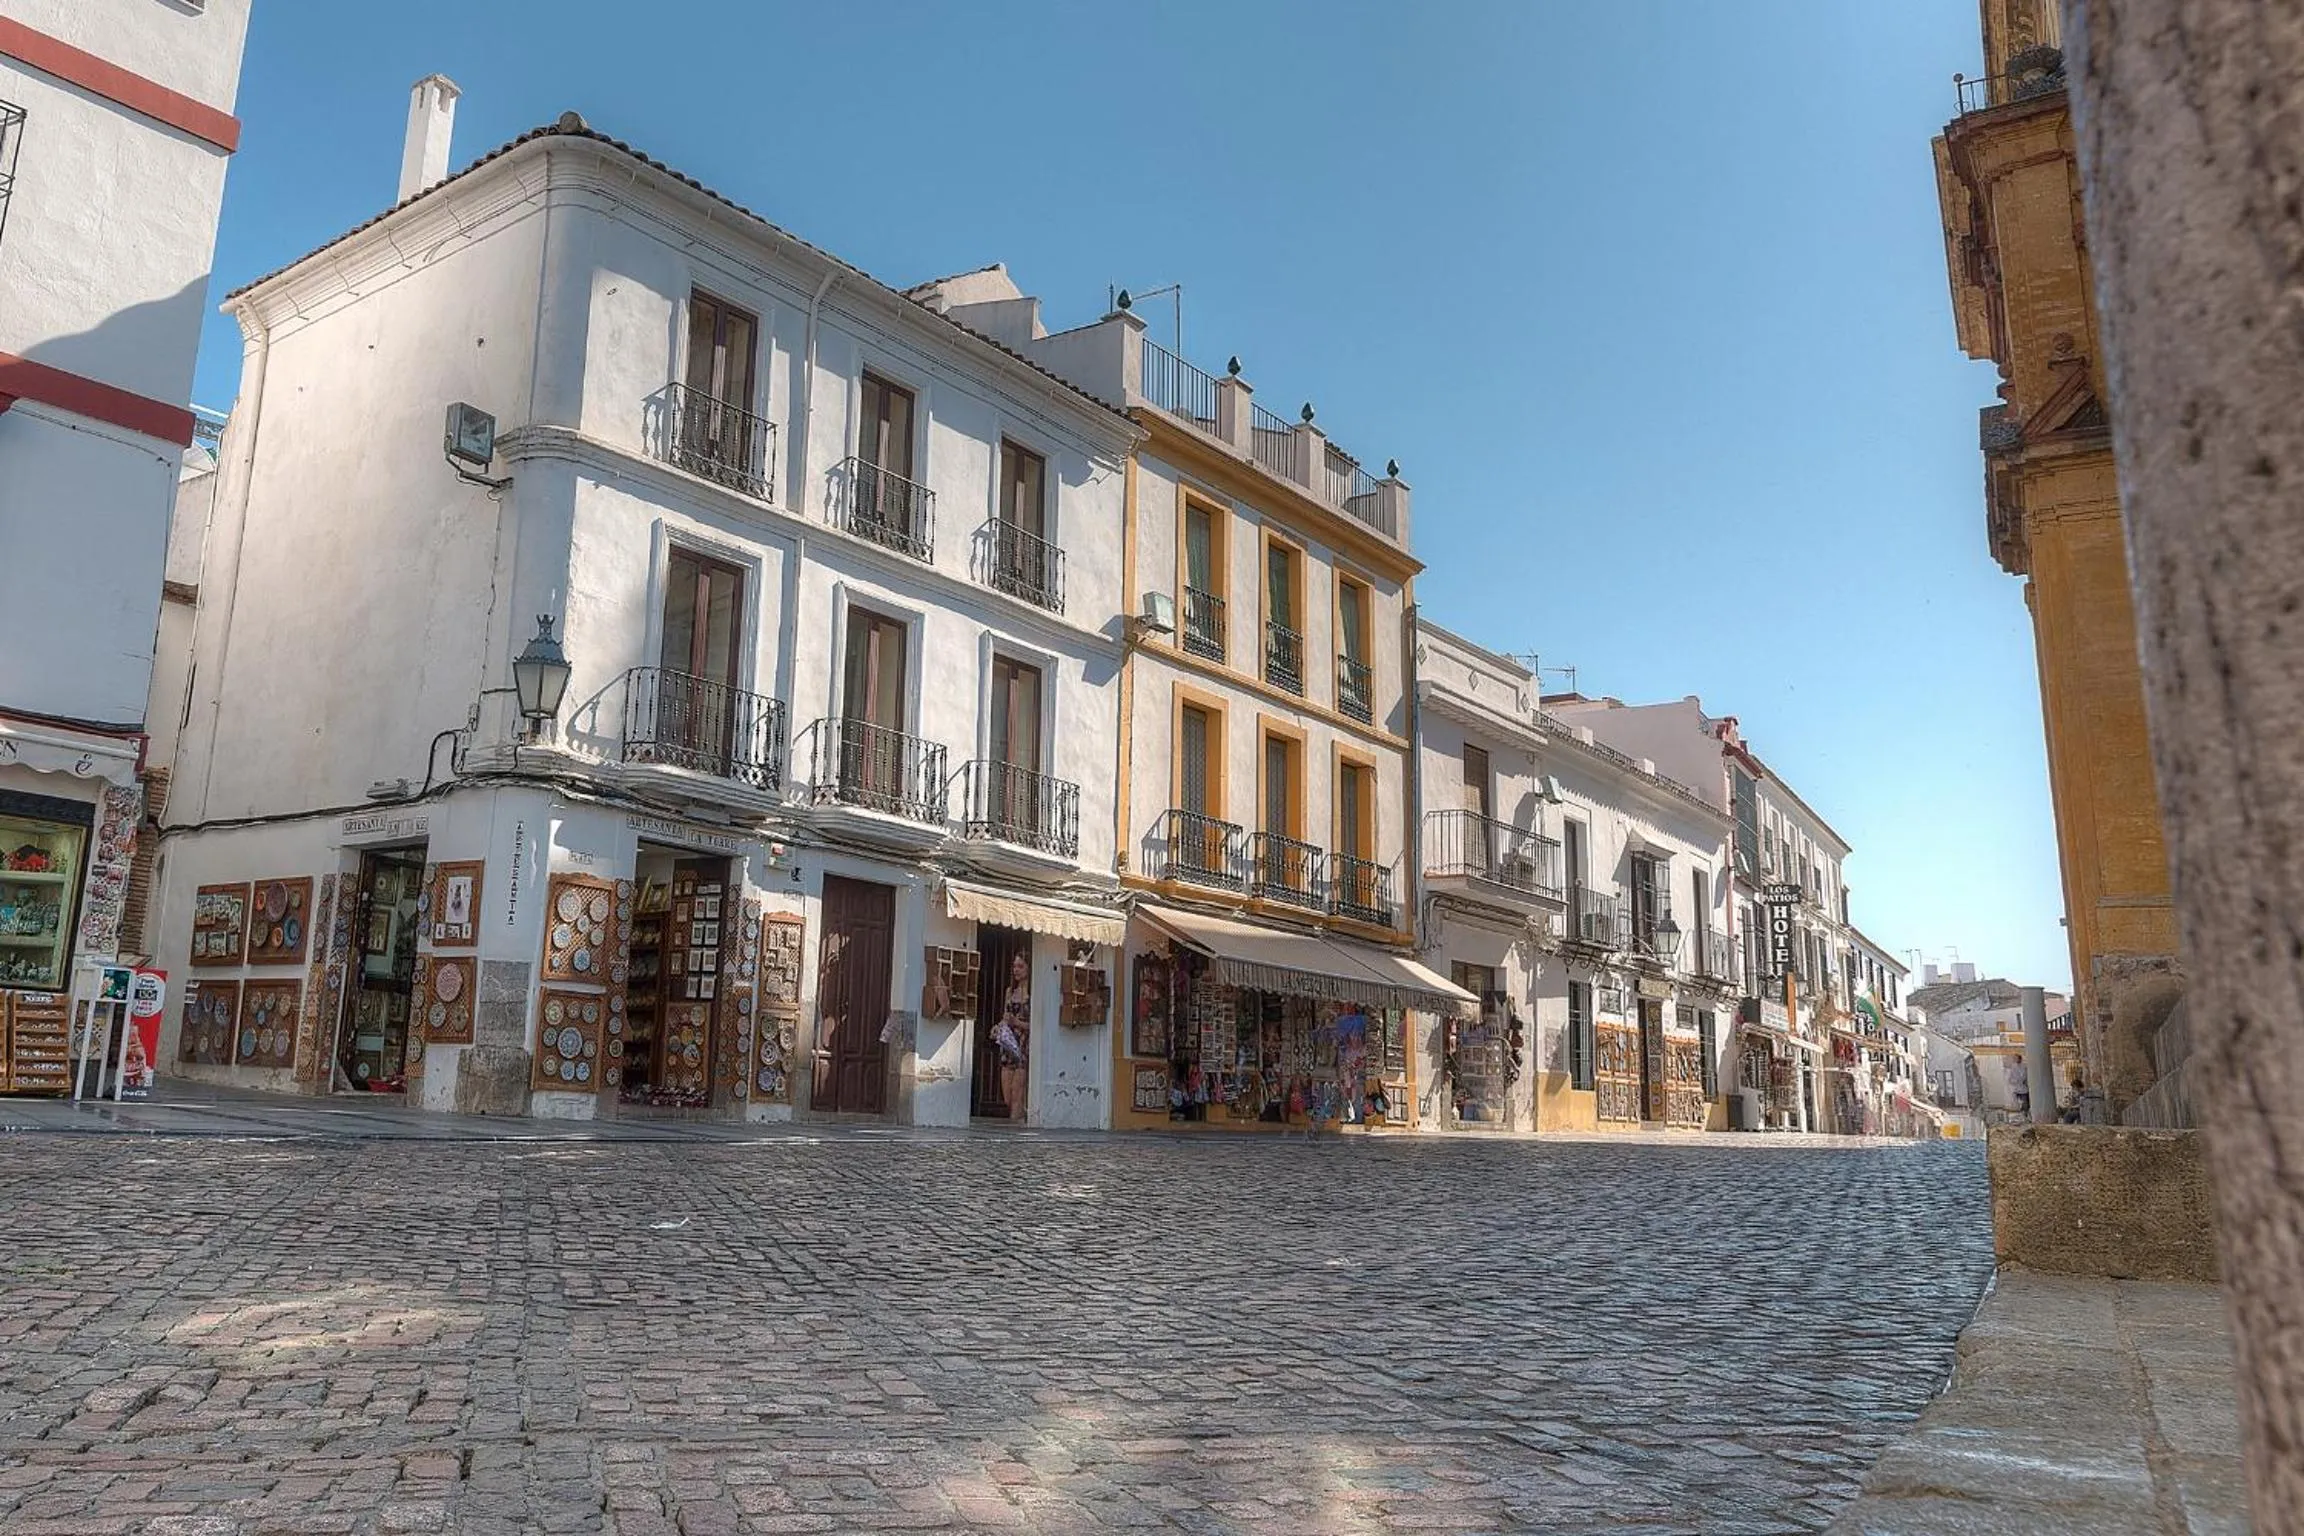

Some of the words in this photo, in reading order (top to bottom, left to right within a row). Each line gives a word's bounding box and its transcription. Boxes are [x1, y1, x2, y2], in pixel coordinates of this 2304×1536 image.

[1769, 886, 1789, 894] LOS
[1762, 893, 1799, 903] PATIOS
[1773, 905, 1789, 976] HOTEL
